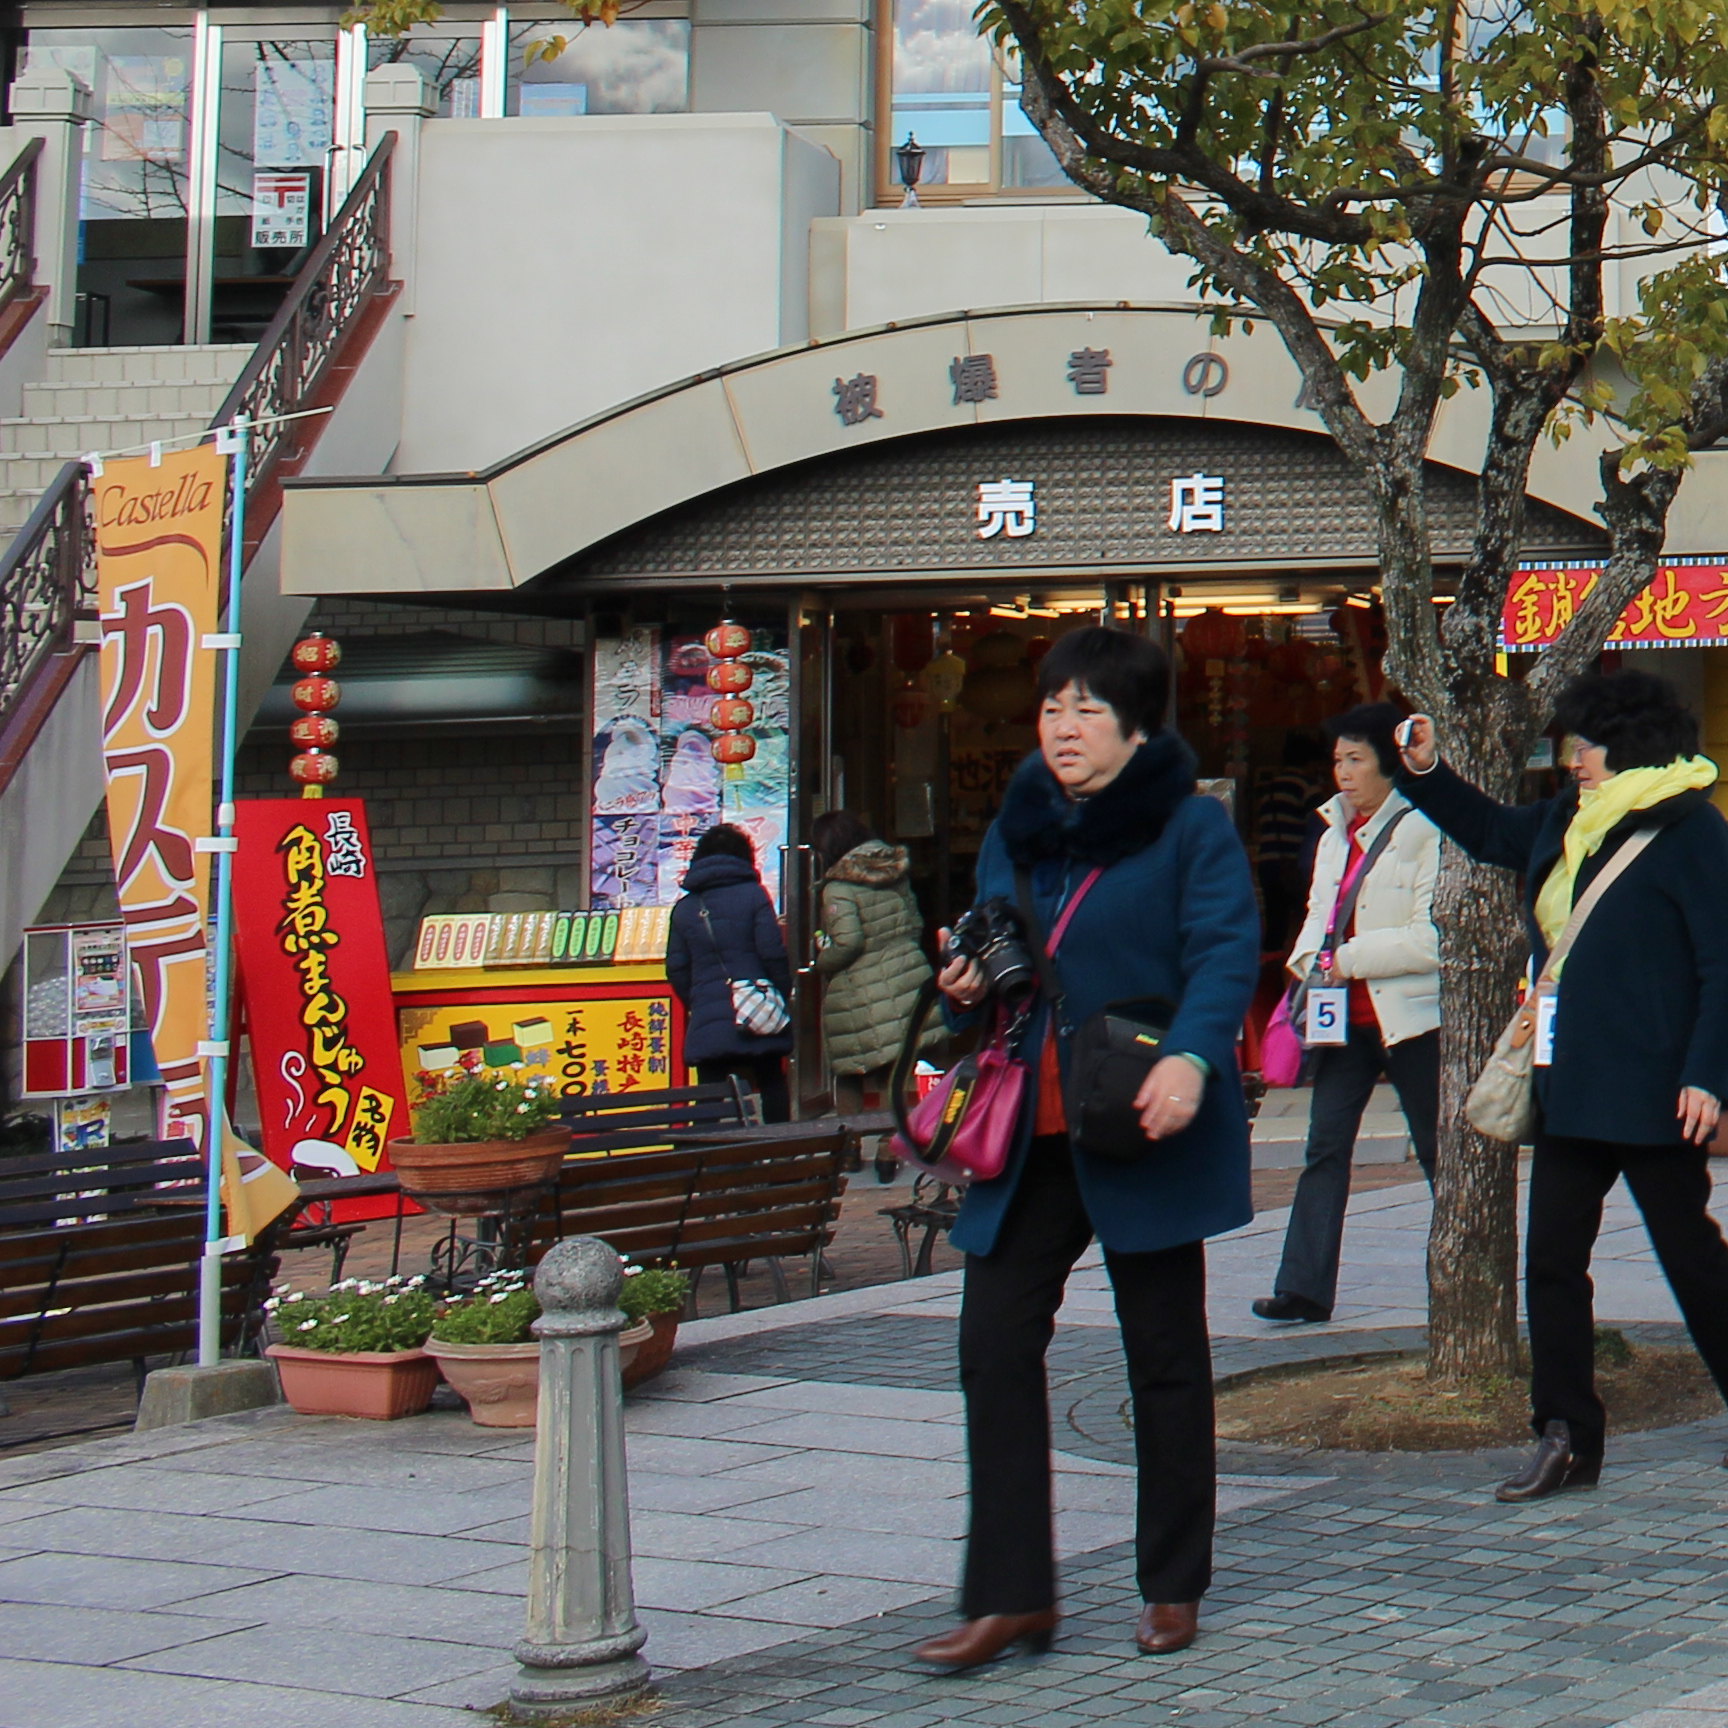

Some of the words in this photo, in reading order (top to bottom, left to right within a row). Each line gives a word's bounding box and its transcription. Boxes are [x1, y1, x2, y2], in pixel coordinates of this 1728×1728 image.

[256, 230, 304, 244] 販売所
[832, 346, 1322, 426] 被爆者の
[101, 471, 213, 528] Castella
[975, 473, 1226, 539] 売店
[325, 812, 365, 878] 長崎
[281, 825, 365, 1138] 角煮まんじゅう
[1318, 1002, 1336, 1028] 5
[352, 1093, 386, 1157] 名物
